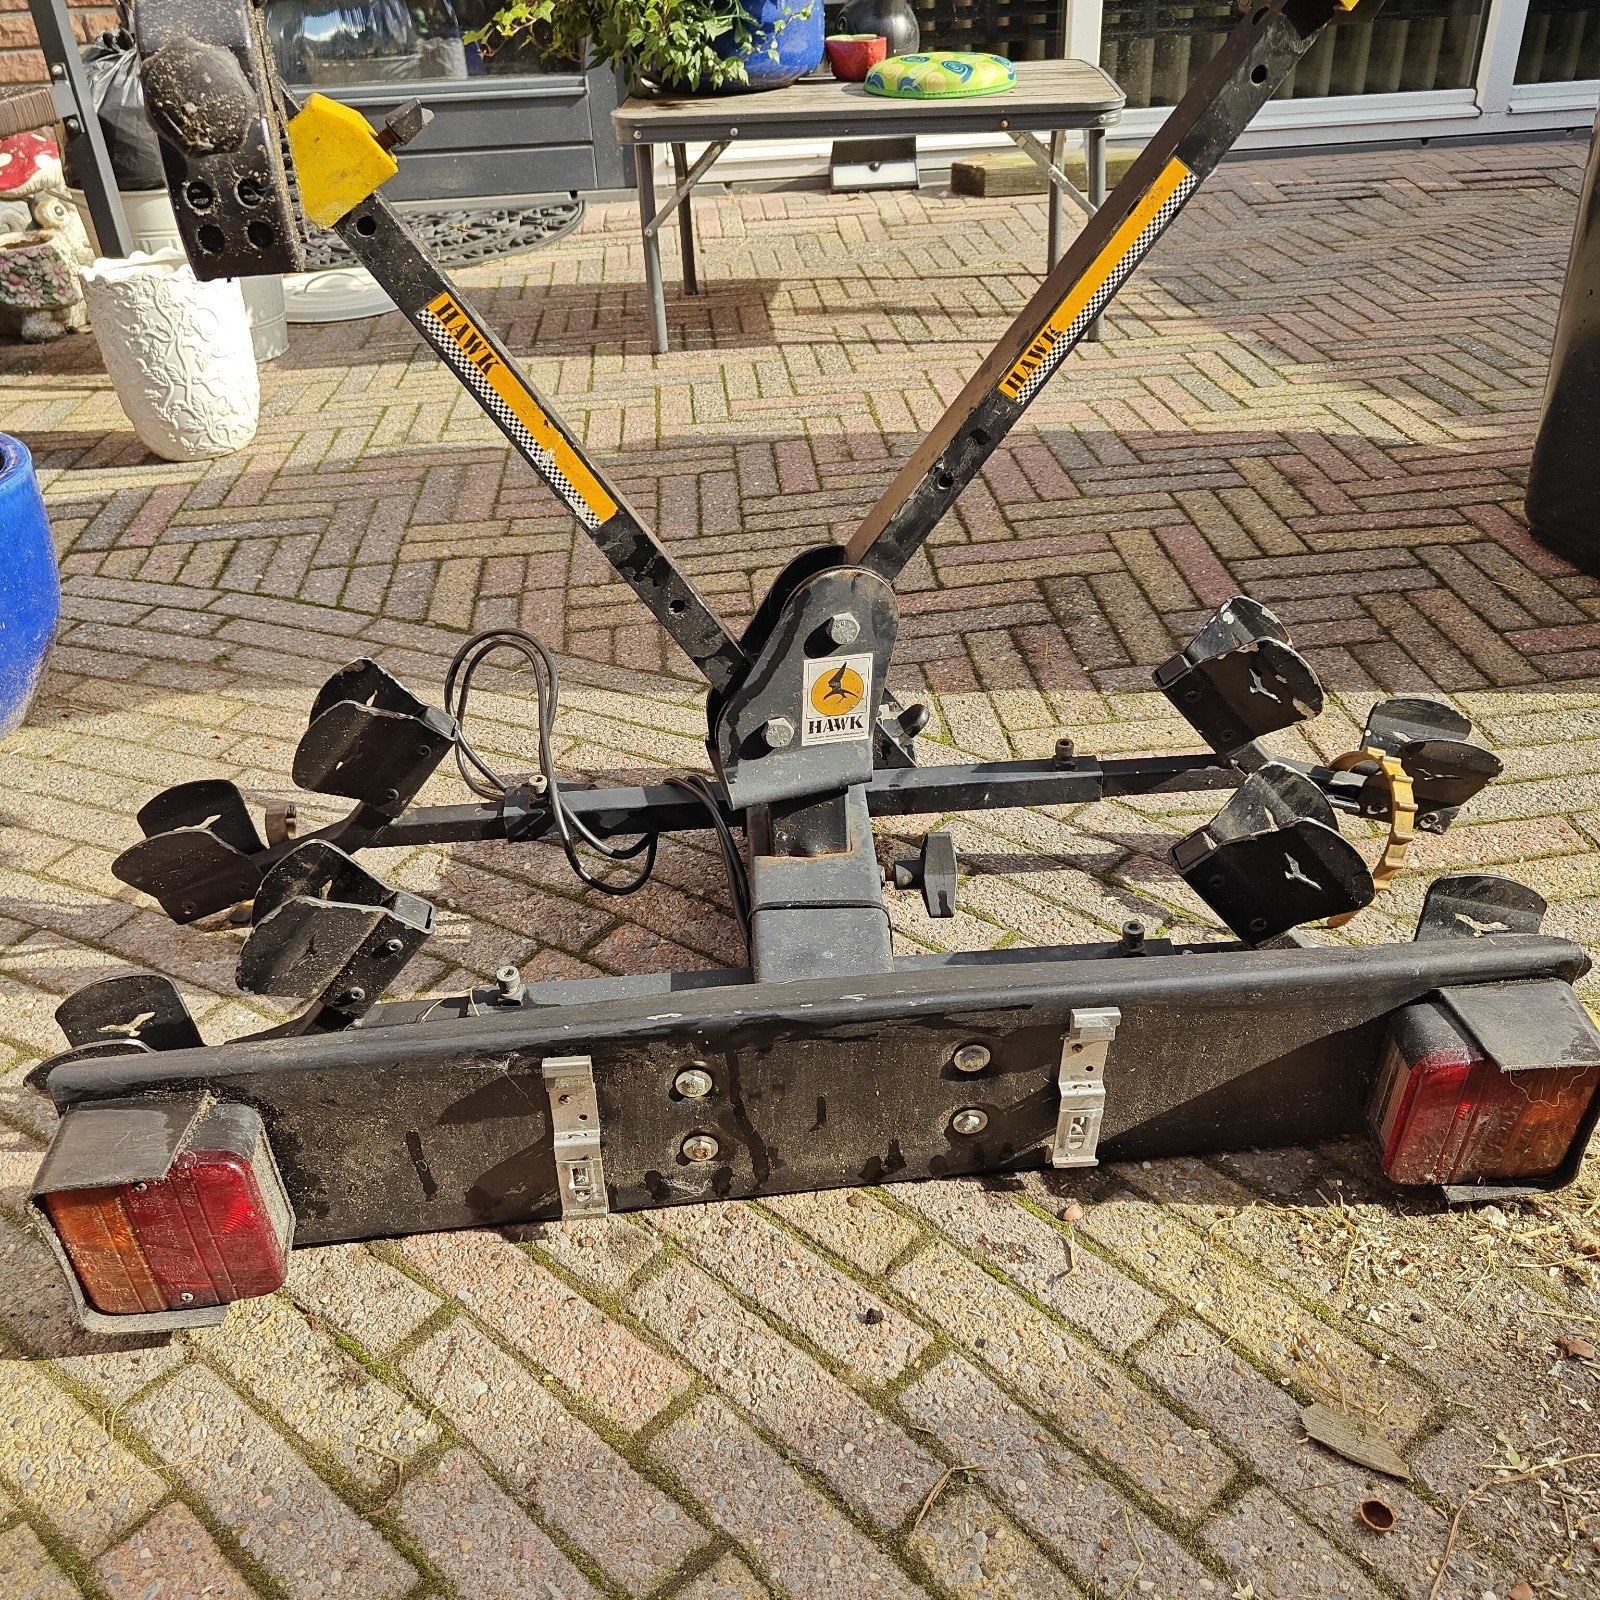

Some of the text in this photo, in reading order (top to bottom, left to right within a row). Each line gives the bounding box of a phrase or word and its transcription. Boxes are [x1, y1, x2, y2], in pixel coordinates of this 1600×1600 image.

[435, 301, 500, 375] HAWK
[1005, 324, 1063, 392] HAWK
[808, 715, 864, 734] HAWK
